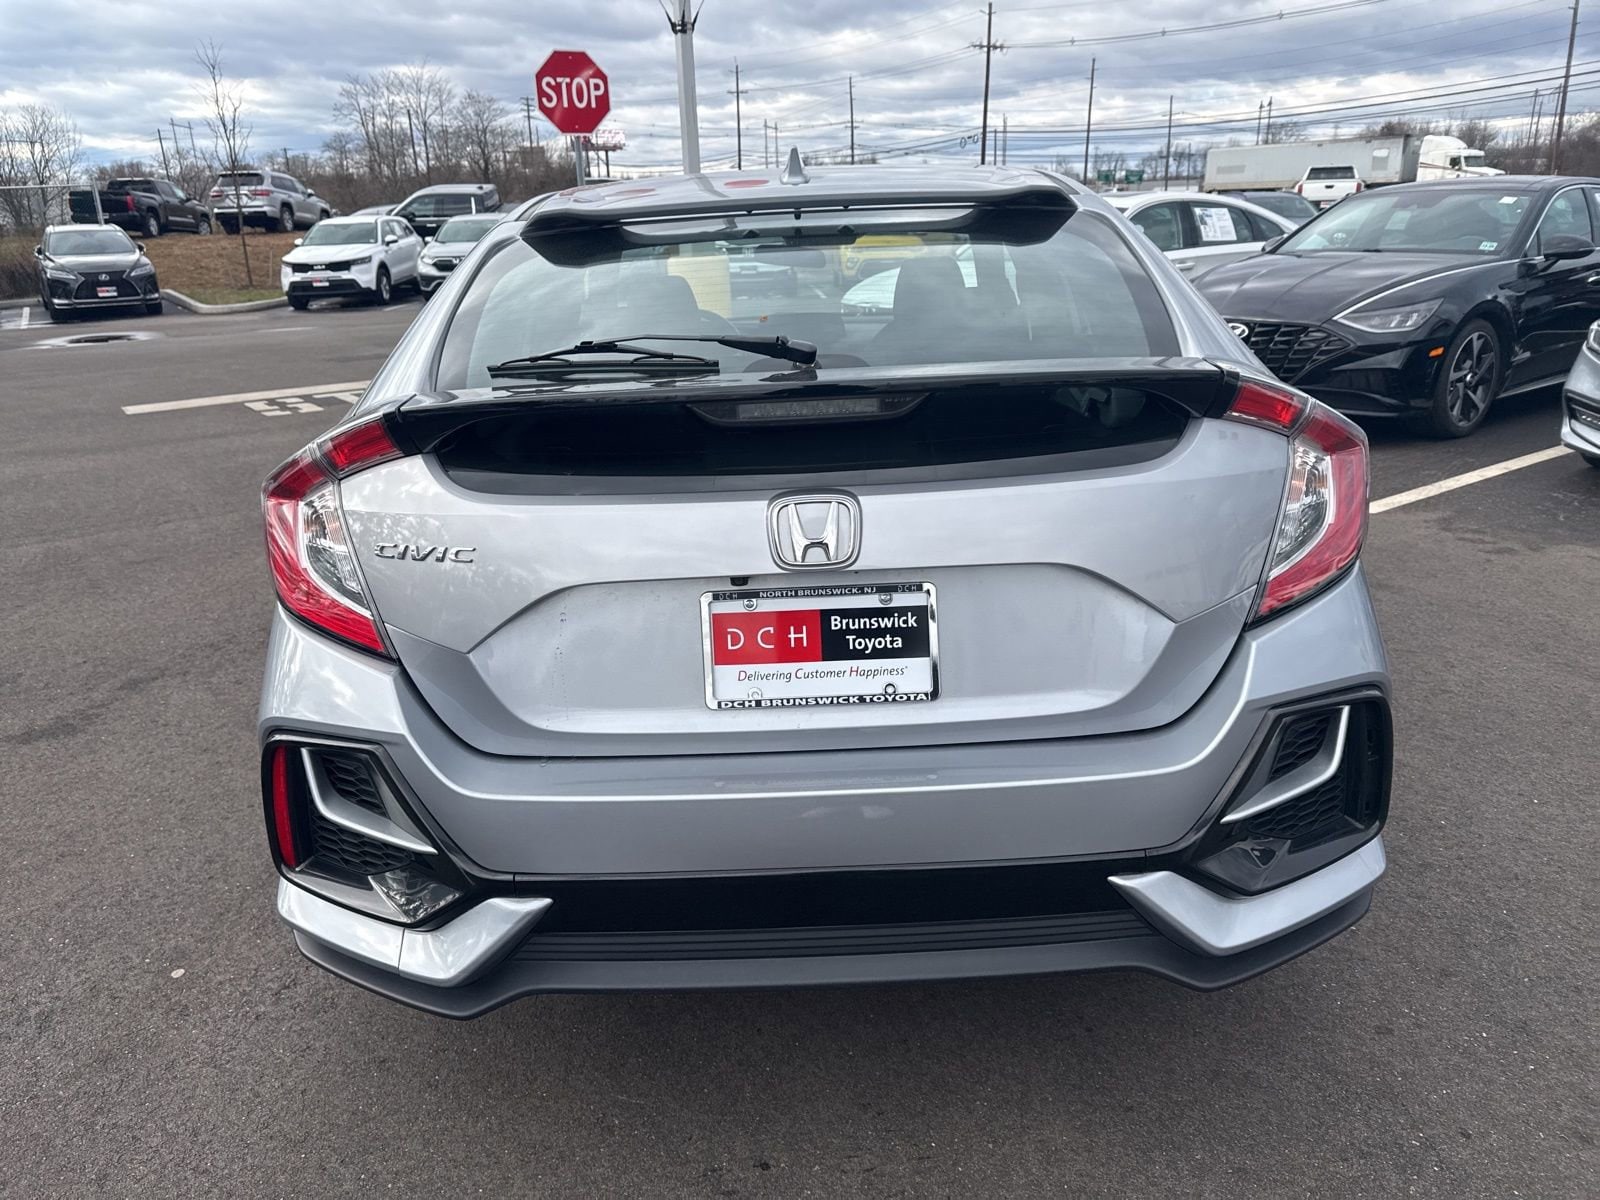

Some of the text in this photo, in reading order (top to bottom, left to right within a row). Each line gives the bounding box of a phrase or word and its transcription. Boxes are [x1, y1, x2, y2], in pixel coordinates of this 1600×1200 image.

[541, 76, 605, 109] STOP
[243, 389, 366, 417] ST
[374, 542, 476, 563] CIVIC
[759, 590, 796, 598] NORTH
[830, 612, 917, 631] Brunswick
[846, 634, 903, 654] Toyota
[737, 670, 792, 683] Delivering
[795, 668, 847, 680] Customer
[720, 693, 927, 709] DCH BRUNSWICK TOYOTA
